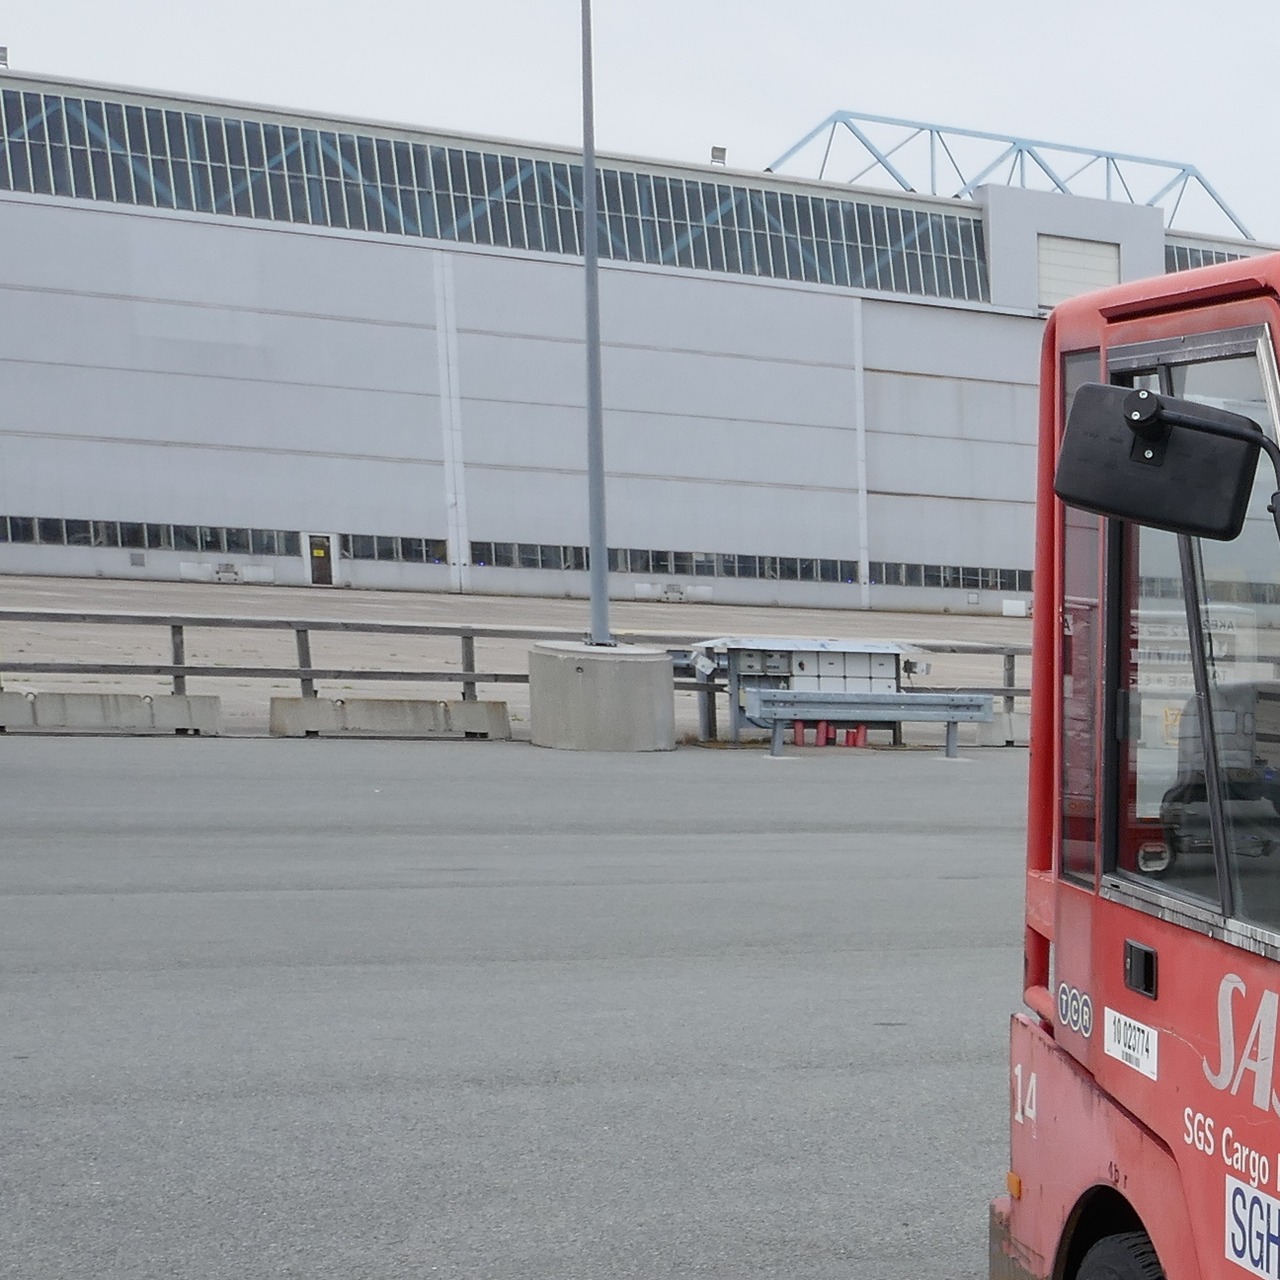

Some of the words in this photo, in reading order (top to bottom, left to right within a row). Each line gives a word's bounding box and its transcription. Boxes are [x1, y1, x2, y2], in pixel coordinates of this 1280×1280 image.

[1060, 991, 1090, 1030] TCR
[1113, 1016, 1122, 1044] 10
[1014, 1063, 1037, 1125] 14
[1183, 1106, 1215, 1156] SGS
[1221, 1126, 1270, 1188] Cargo
